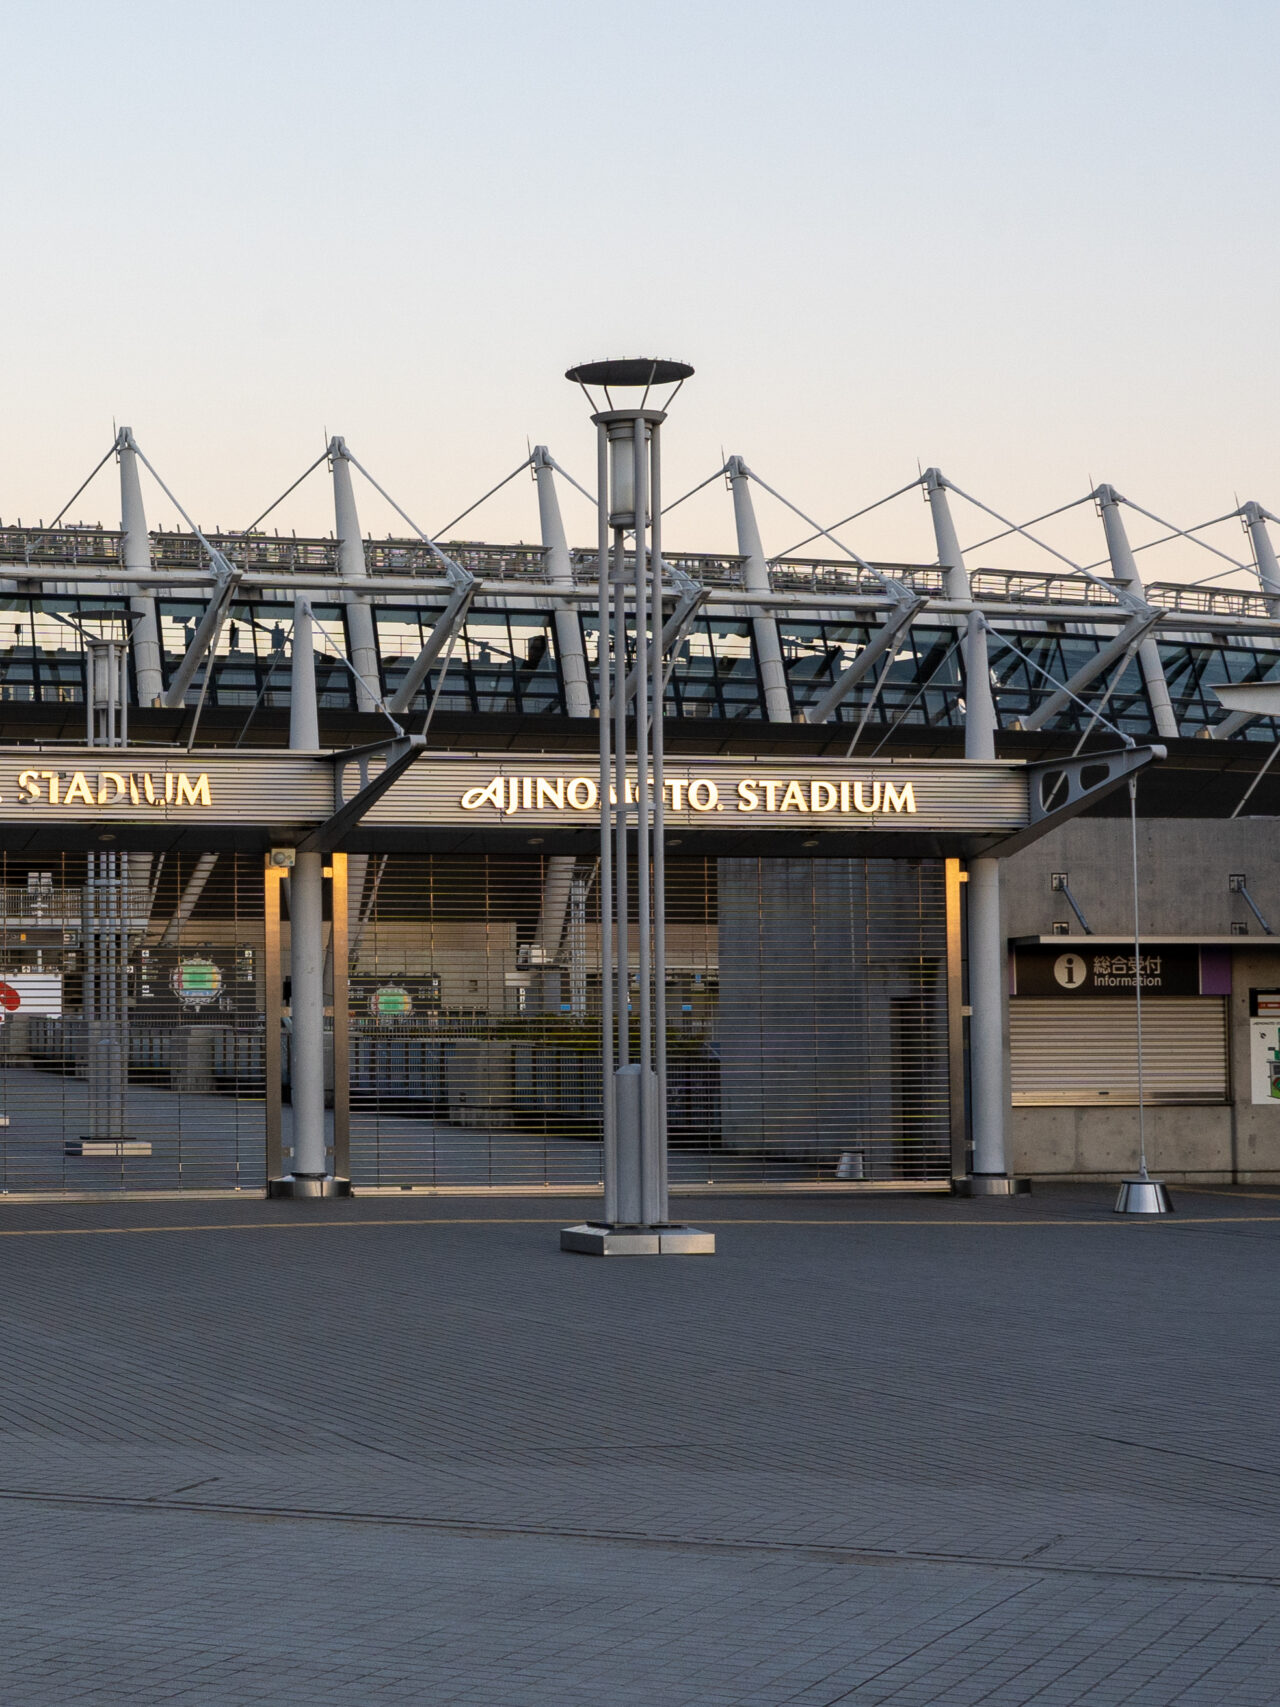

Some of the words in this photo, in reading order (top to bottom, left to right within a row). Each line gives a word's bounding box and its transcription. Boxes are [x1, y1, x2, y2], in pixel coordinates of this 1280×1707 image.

[19, 770, 213, 807] STADIUM
[737, 778, 918, 813] STADIUM
[1093, 956, 1161, 974] 総合受付
[1094, 975, 1161, 986] Information
